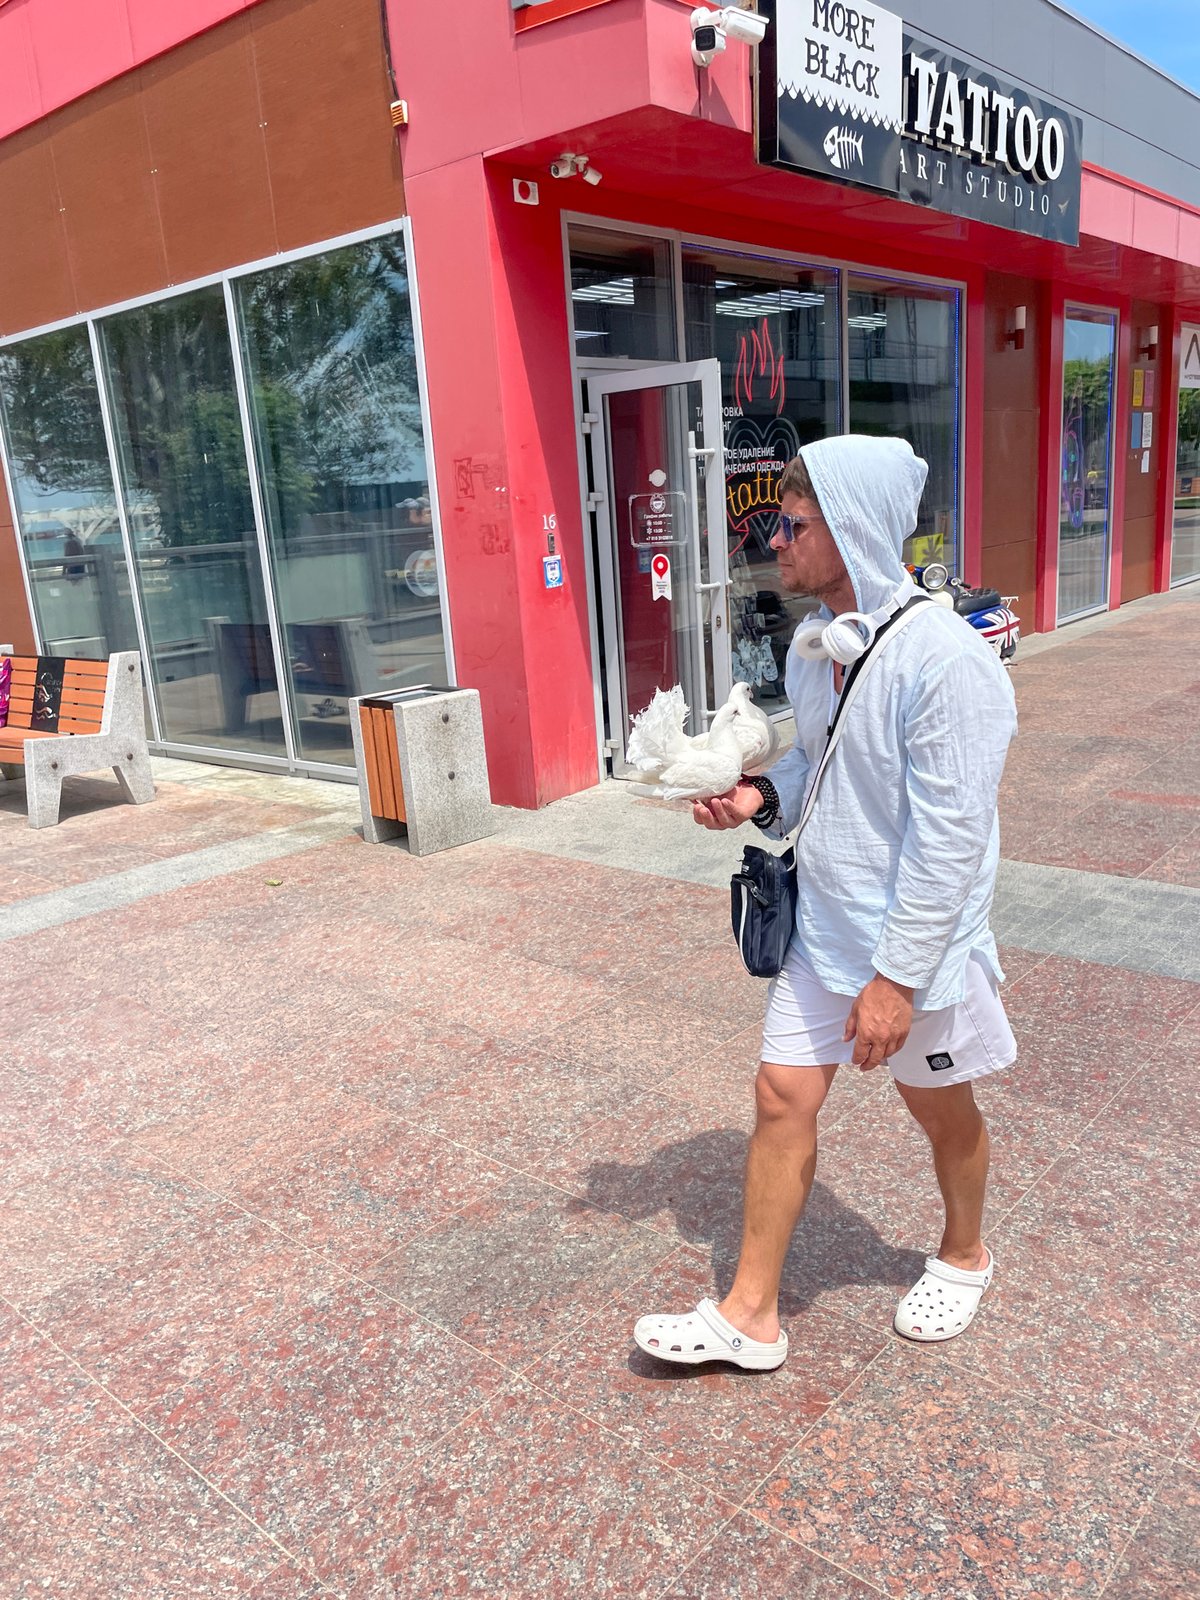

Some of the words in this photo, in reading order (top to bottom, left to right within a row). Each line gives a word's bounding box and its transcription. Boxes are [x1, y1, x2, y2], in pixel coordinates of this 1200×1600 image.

[812, 0, 875, 52] MORE
[805, 38, 879, 99] BLACK
[911, 52, 1064, 180] TATTOO
[966, 171, 1049, 215] STUDIO
[739, 446, 775, 460] УДАЛЕНИЕ
[757, 460, 785, 473] ОДЕЖДА
[543, 513, 556, 530] 16
